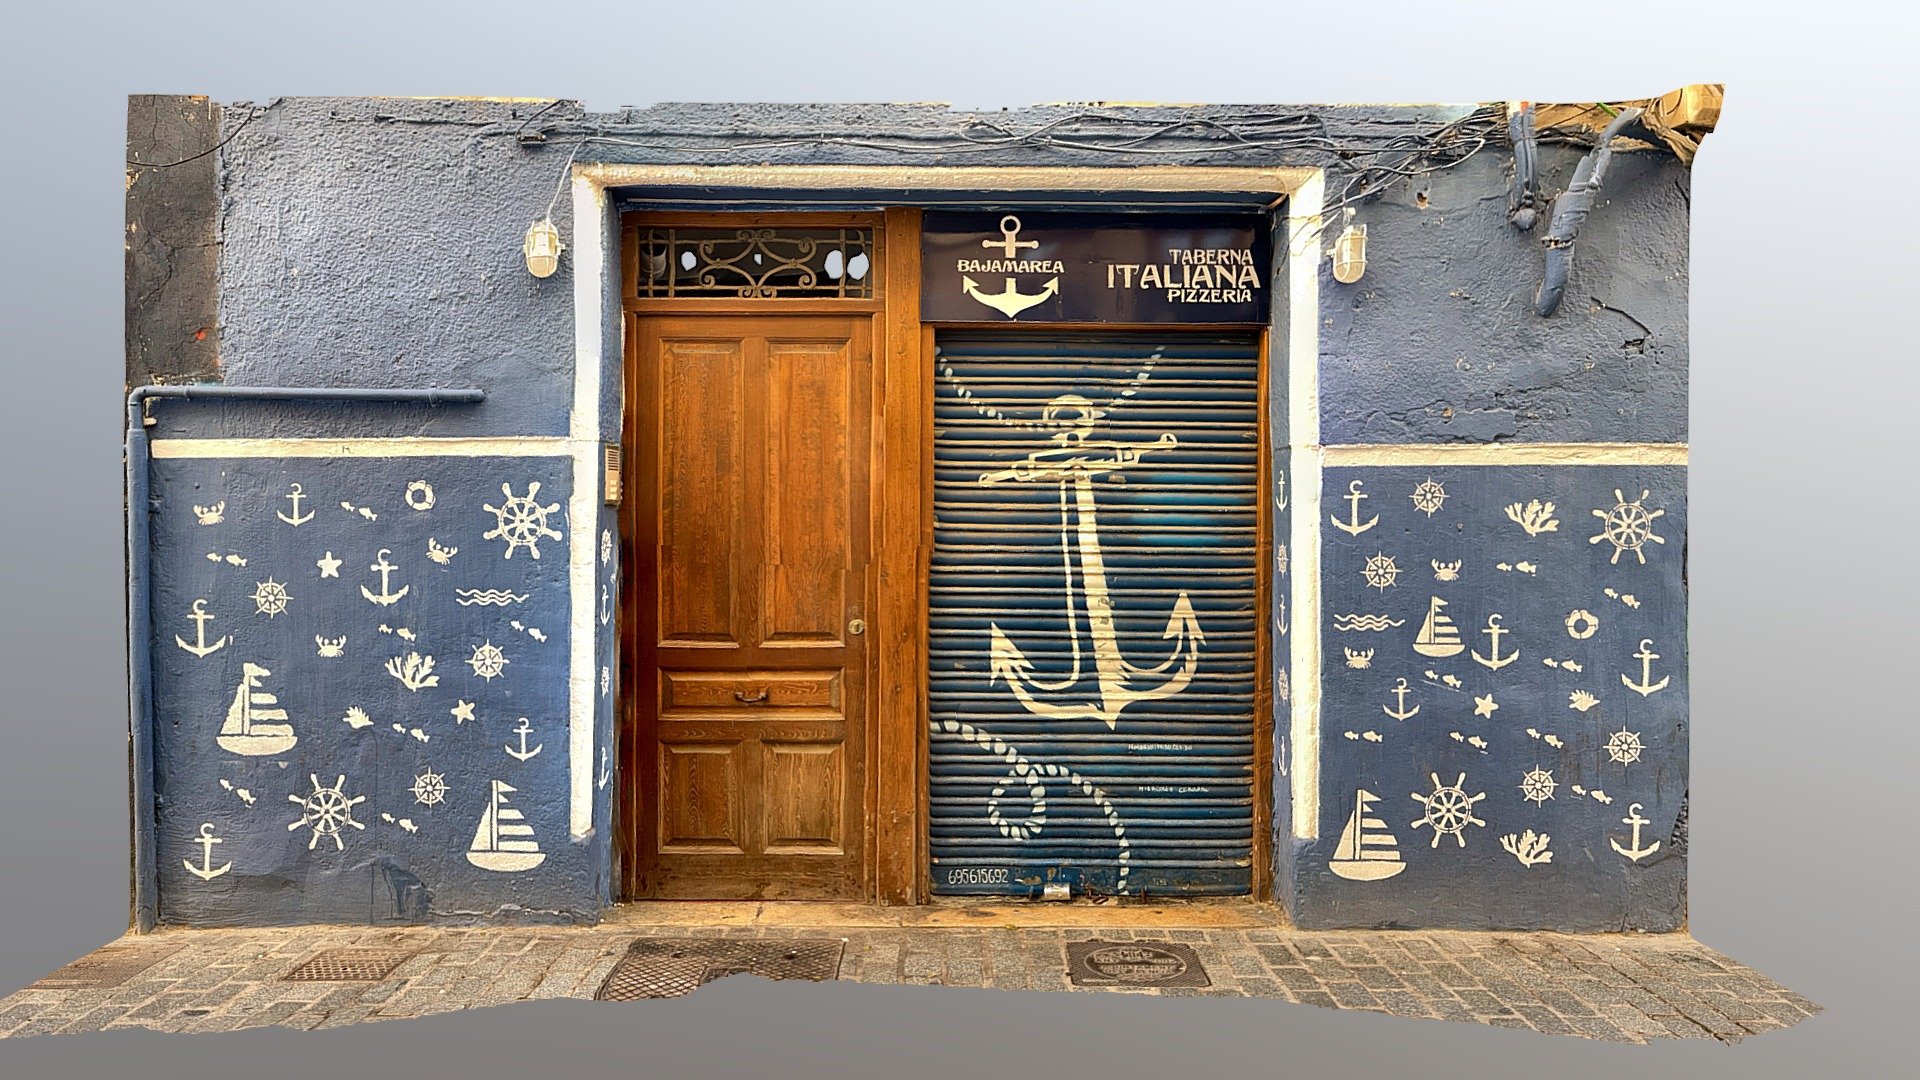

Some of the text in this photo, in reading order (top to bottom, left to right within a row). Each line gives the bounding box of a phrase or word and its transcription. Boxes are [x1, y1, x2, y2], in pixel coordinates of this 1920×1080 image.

[1168, 248, 1254, 265] TABERNA
[956, 258, 1066, 274] BAJAMAREA
[1106, 263, 1262, 290] ITALIANA
[1166, 289, 1253, 304] PIZZERIA
[948, 868, 1008, 884] 695615692
